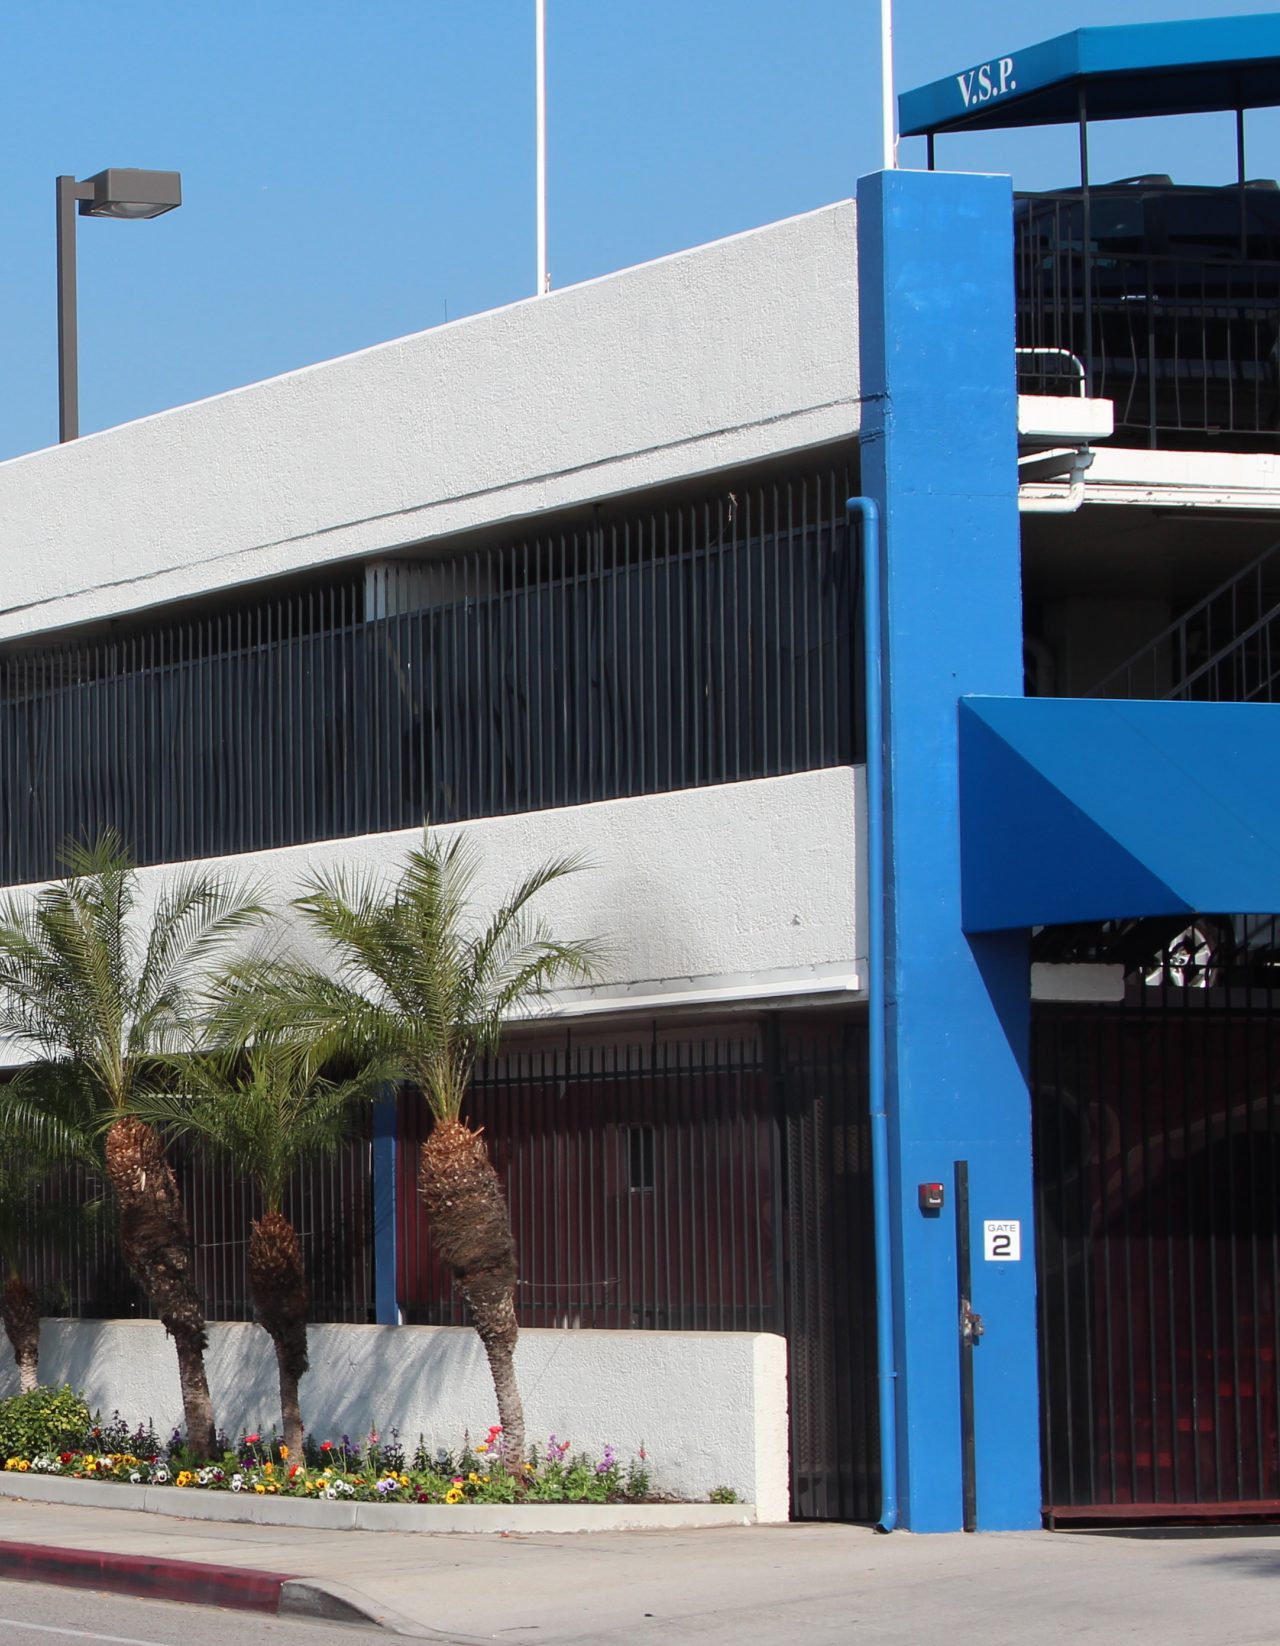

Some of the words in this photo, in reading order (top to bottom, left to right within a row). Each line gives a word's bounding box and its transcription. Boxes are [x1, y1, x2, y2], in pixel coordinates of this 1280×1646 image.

[956, 57, 1017, 108] V.S.P.
[987, 1224, 1017, 1232] GATE
[992, 1234, 1011, 1257] 2
